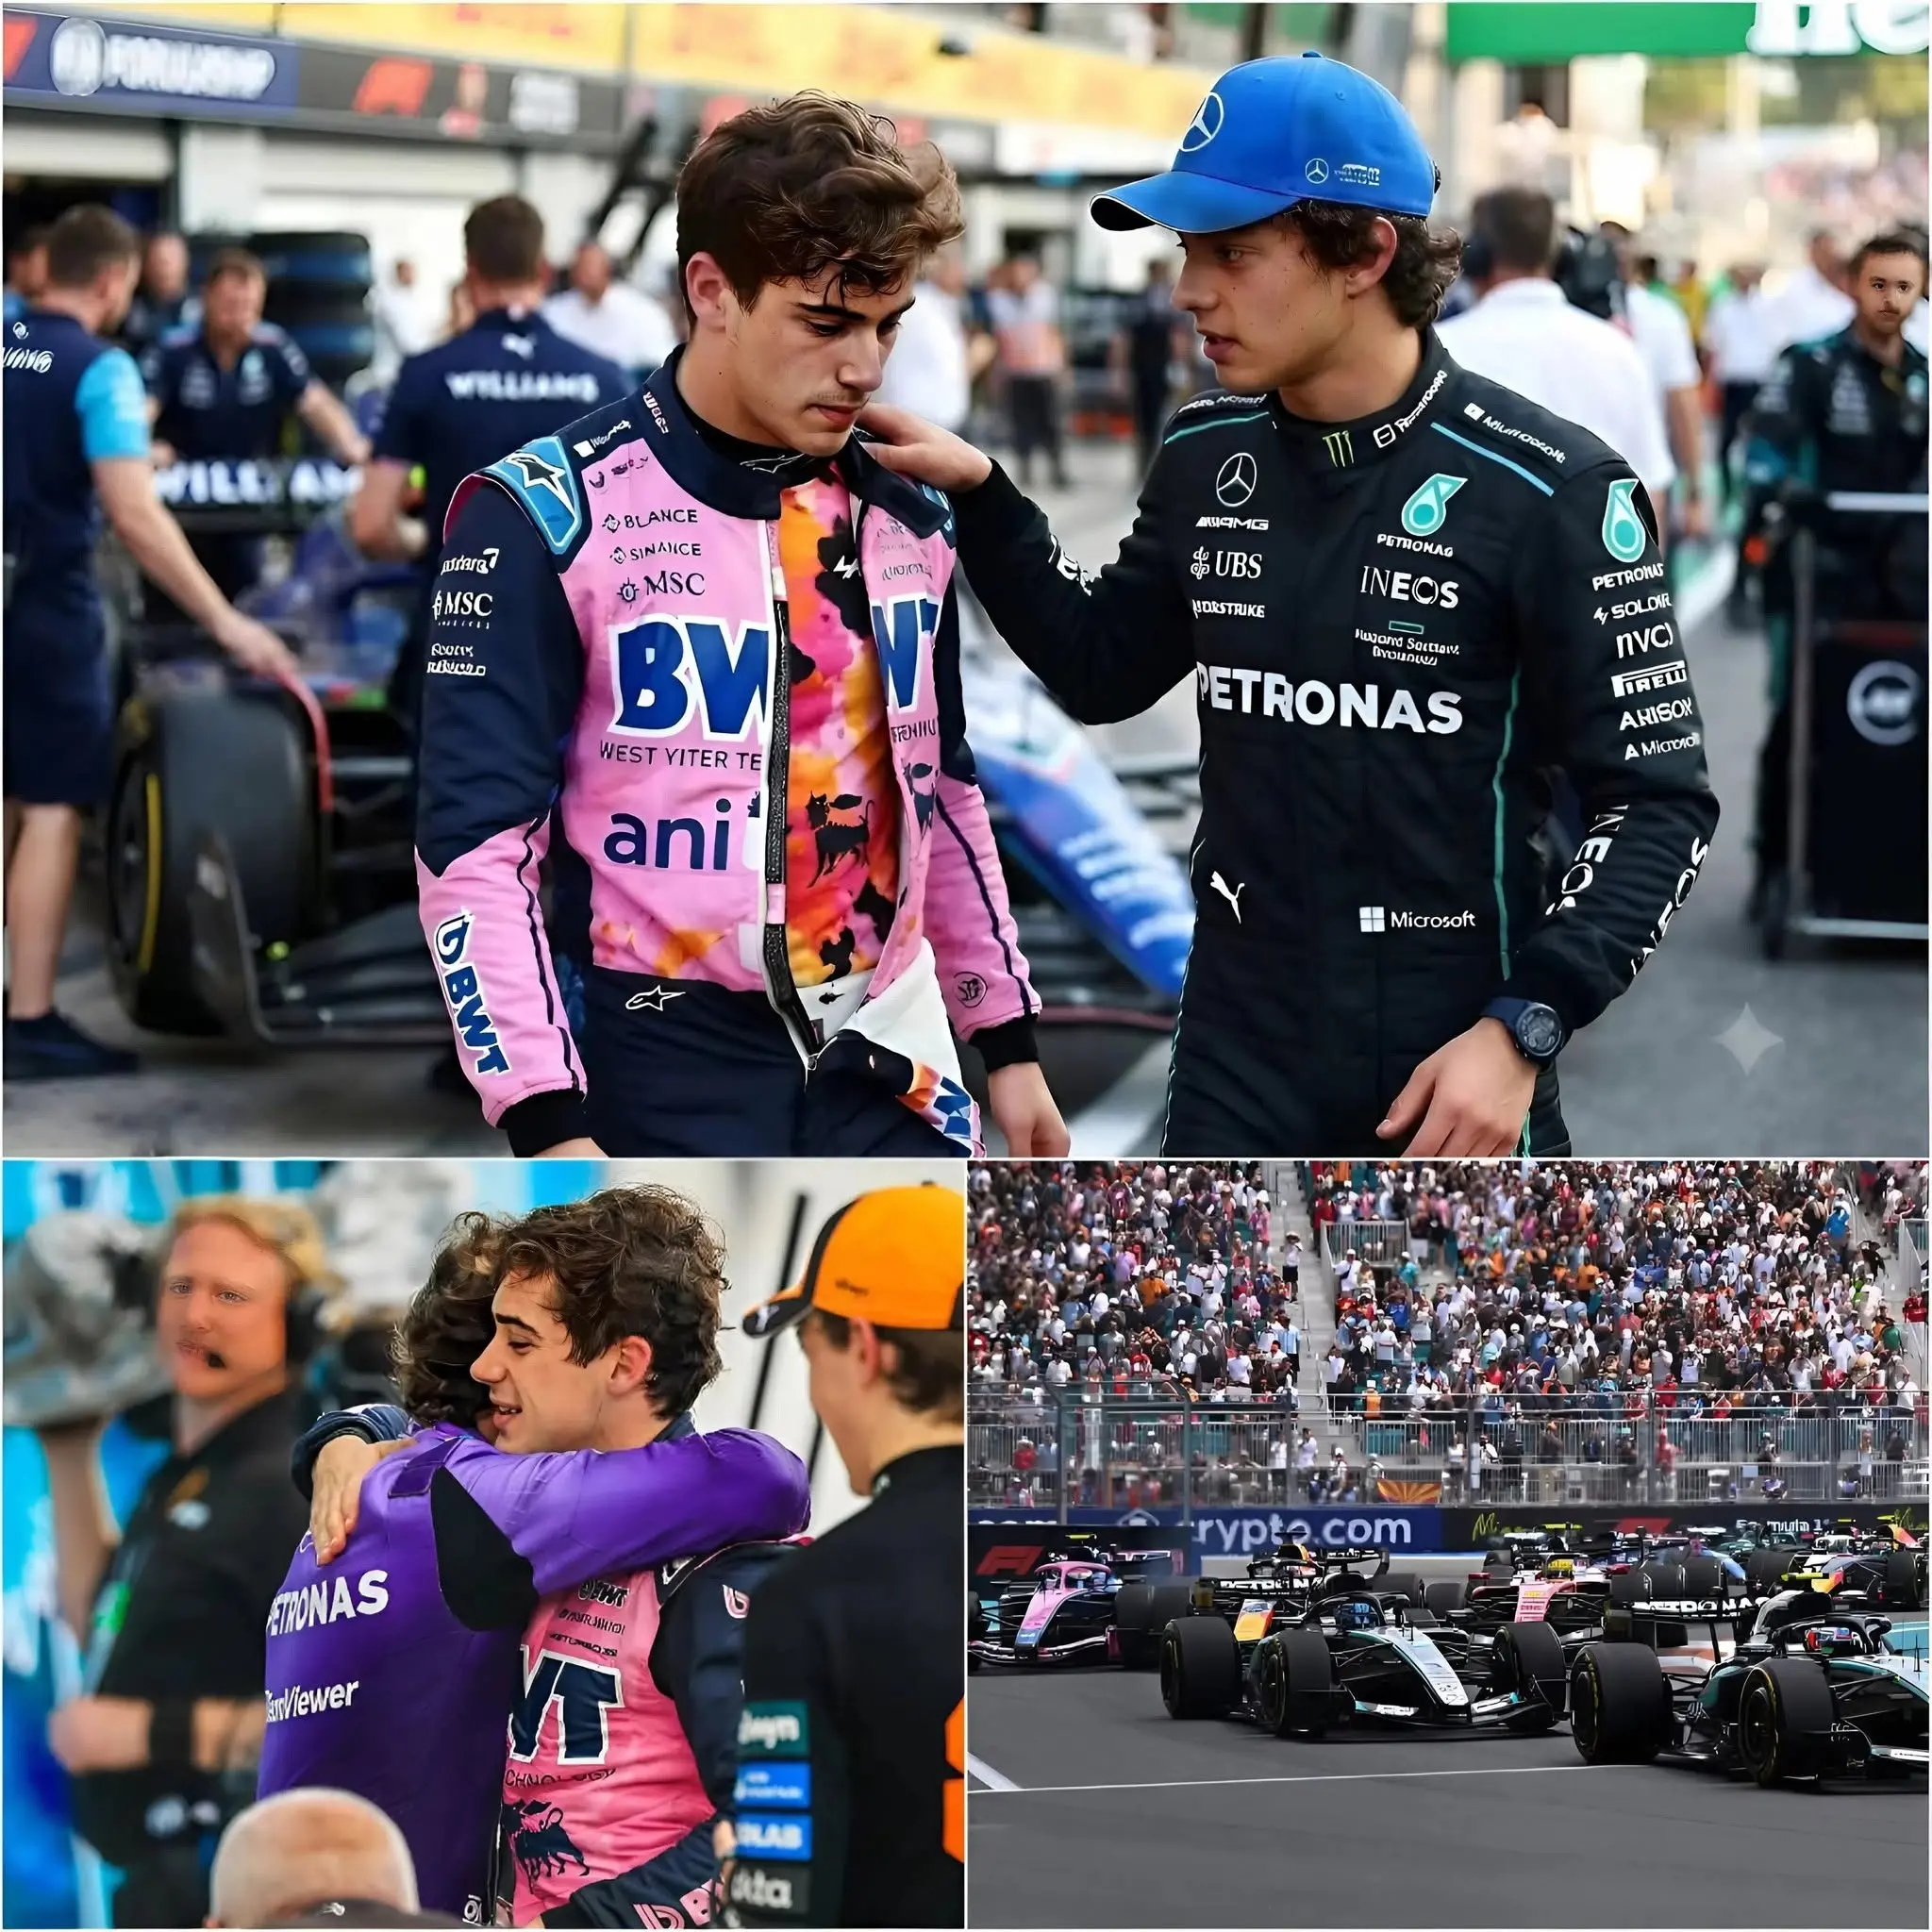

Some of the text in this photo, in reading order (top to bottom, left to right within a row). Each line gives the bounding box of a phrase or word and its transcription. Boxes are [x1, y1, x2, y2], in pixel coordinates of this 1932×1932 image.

[1215, 550, 1262, 579] UBS
[643, 570, 706, 595] MSC
[444, 591, 493, 617] MSC
[600, 740, 658, 762] WEST
[664, 746, 728, 769] YITER
[603, 798, 732, 871] ani
[1391, 910, 1476, 928] Microsoft
[1191, 1512, 1411, 1552] rypto.com
